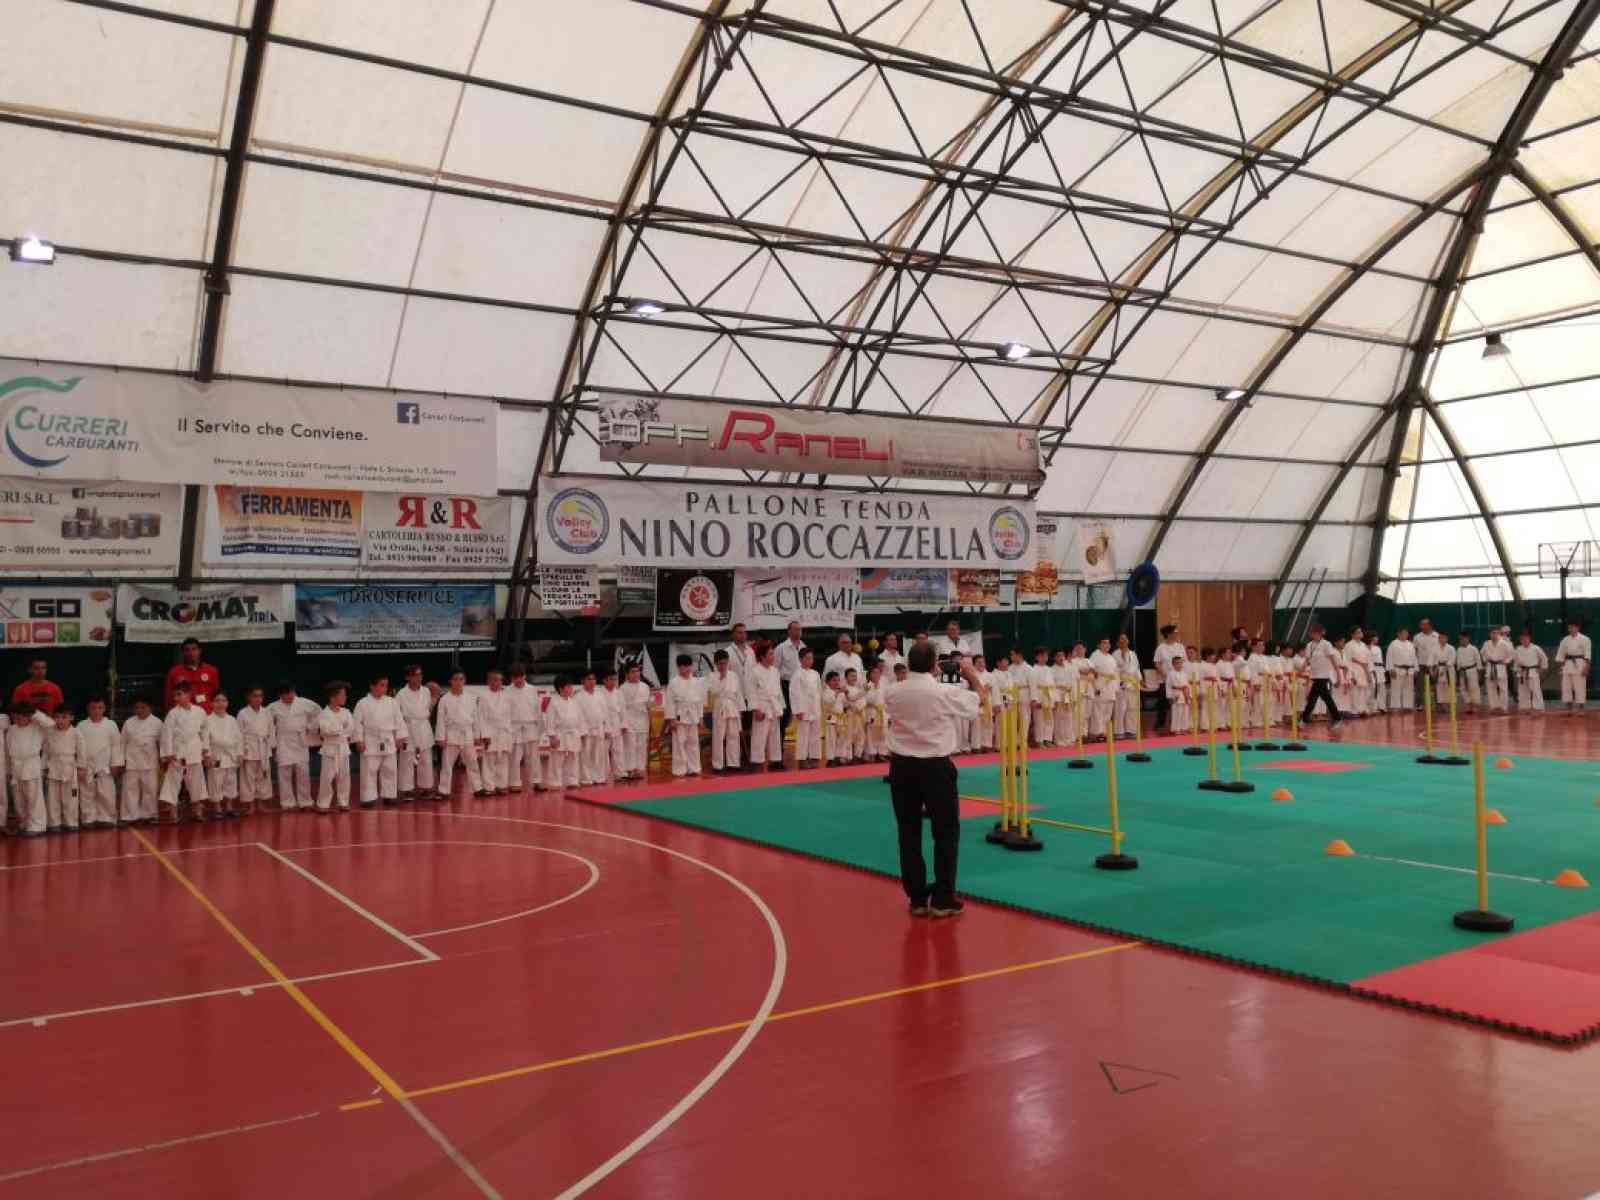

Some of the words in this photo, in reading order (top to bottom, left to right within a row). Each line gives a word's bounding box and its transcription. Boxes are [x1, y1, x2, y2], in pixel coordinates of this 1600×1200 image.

[15, 406, 129, 436] CURRERI
[178, 417, 188, 433] Il
[195, 419, 251, 434] Servito
[256, 421, 285, 437] che
[291, 423, 369, 441] Conviene.
[45, 435, 140, 452] CARBURANTI
[240, 493, 353, 519] FERRAMENTA
[685, 491, 826, 518] PALLONE
[841, 499, 931, 521] TENDA
[368, 530, 423, 541] CARTOLERIA
[373, 543, 387, 551] Via
[619, 517, 731, 558] NINO
[747, 521, 987, 561] ROCCAZZELLA
[368, 553, 384, 562] Tel.
[446, 555, 461, 563] Fax
[132, 596, 260, 623] CROMAT
